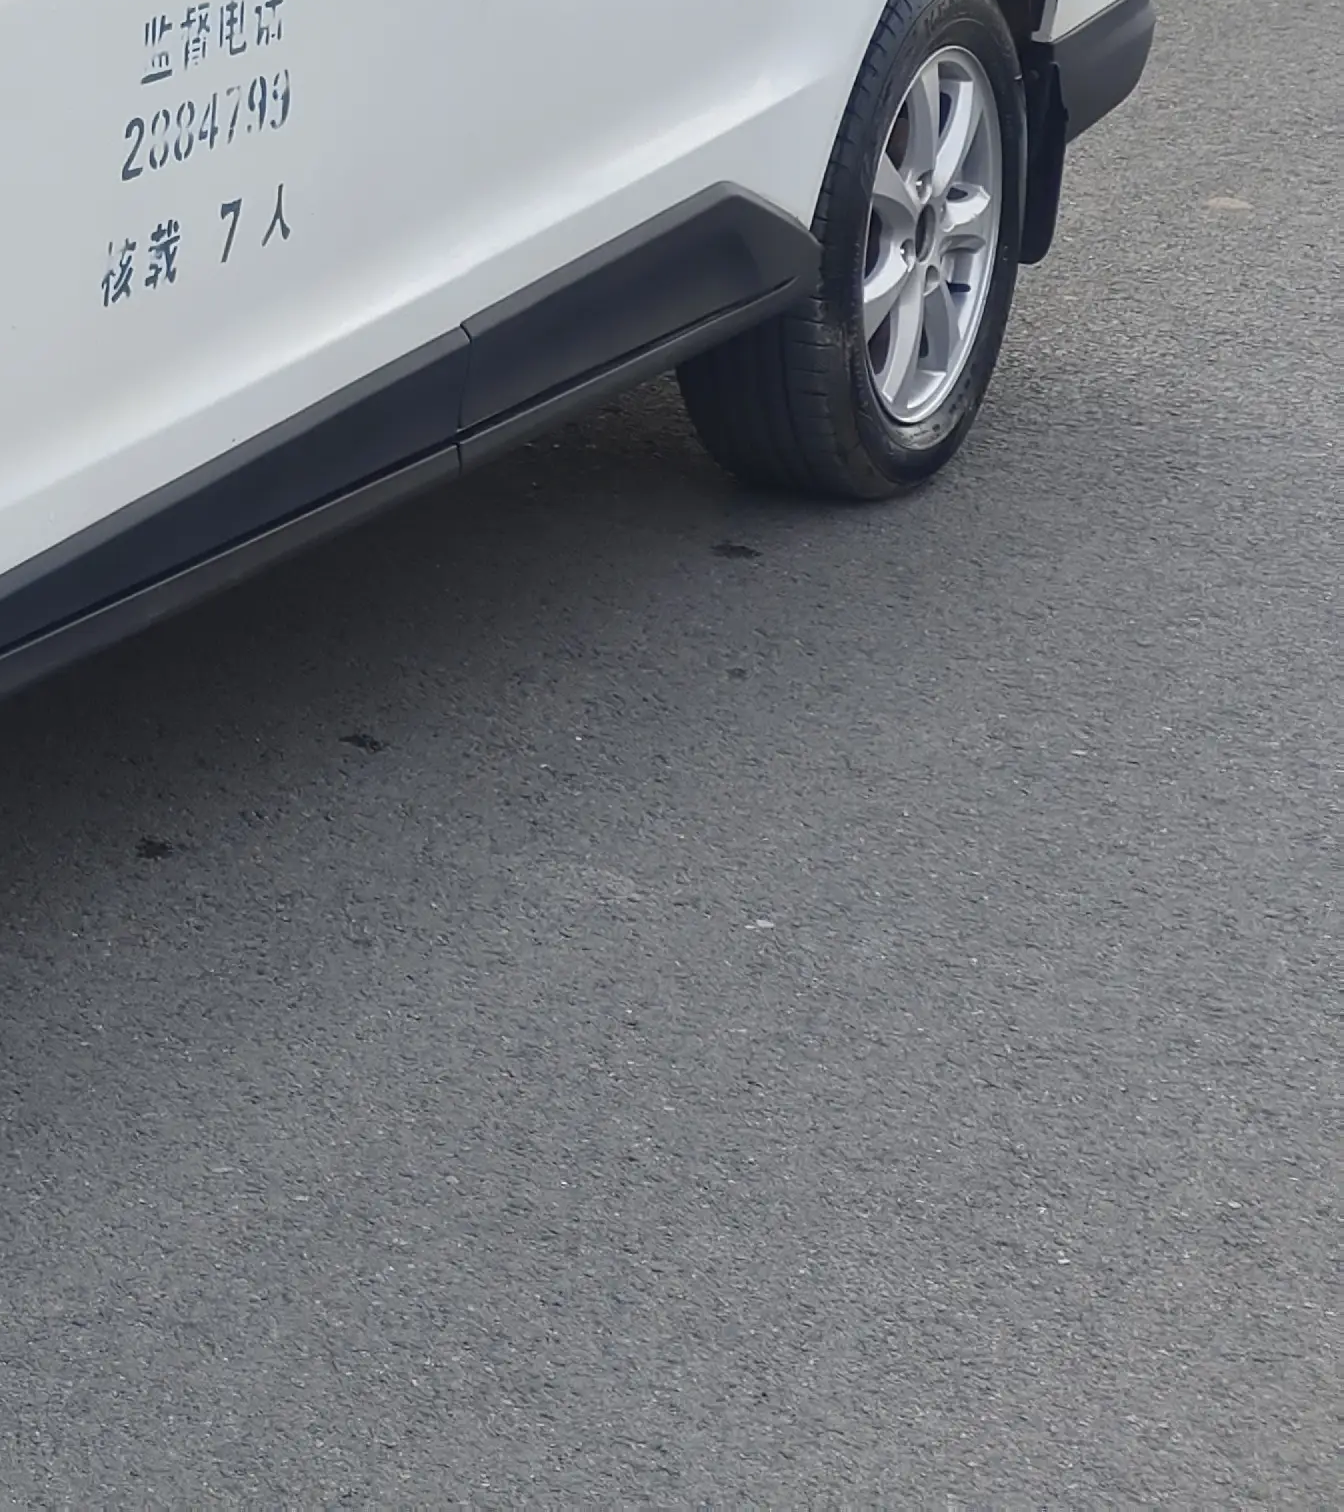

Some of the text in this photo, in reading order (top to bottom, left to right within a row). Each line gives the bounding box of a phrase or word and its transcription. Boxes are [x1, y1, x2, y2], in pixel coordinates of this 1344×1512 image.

[121, 69, 290, 181] 2884799
[101, 183, 291, 307] 核载 7 人
